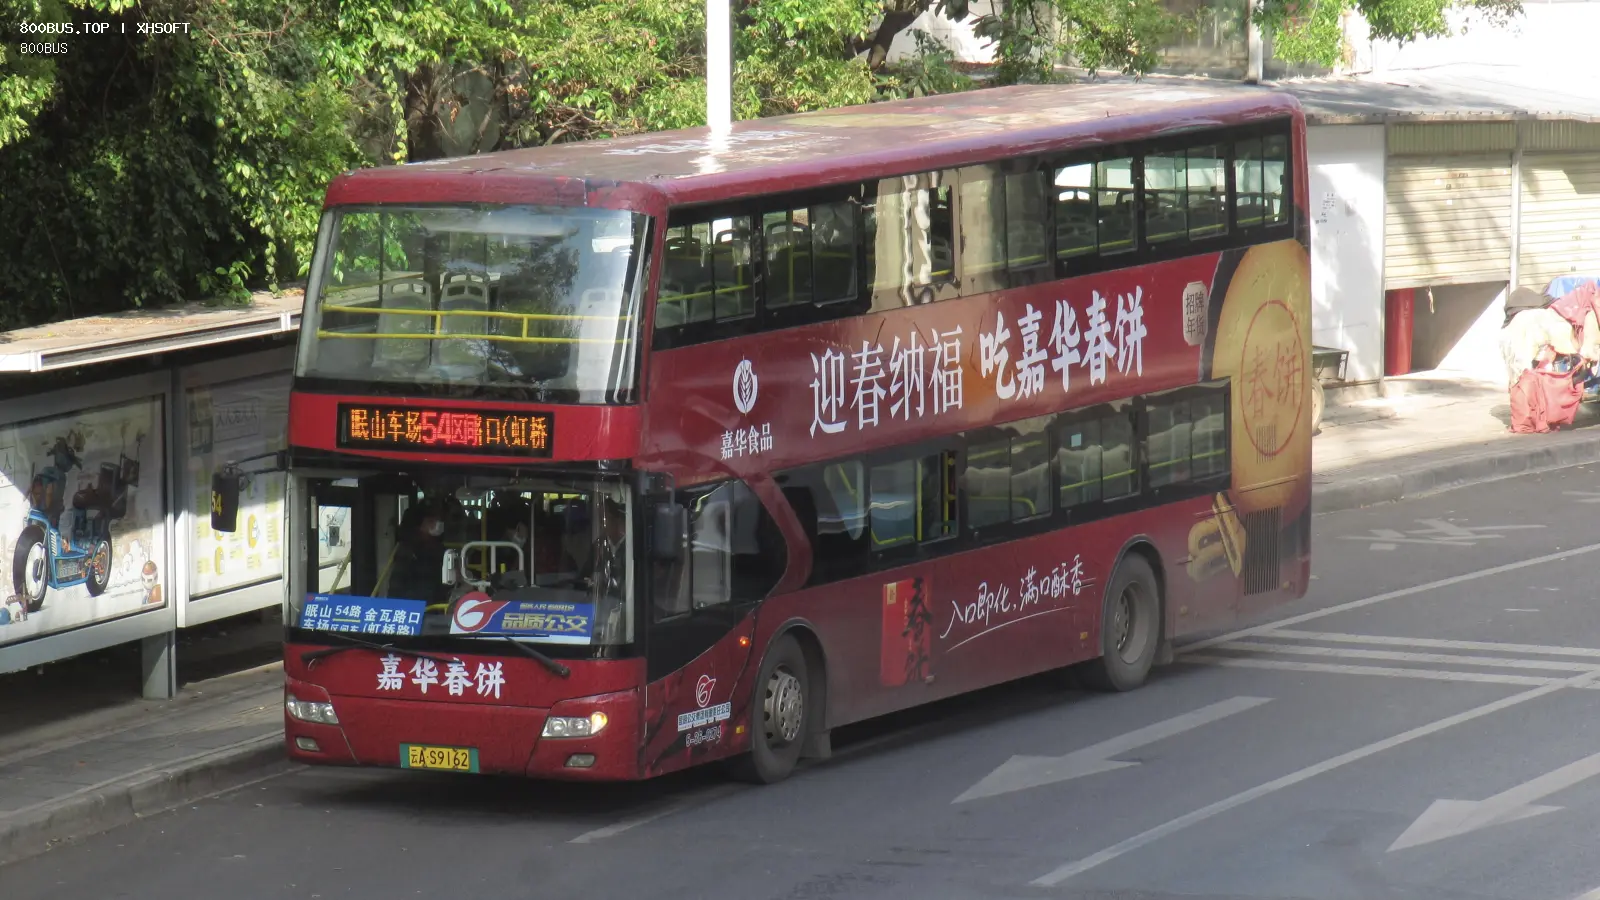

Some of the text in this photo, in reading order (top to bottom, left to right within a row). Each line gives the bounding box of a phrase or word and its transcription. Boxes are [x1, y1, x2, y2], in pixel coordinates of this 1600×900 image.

[1186, 293, 1205, 316] 招牌
[1186, 314, 1205, 338] 年货
[809, 285, 1148, 439] 迎春纳福 吃嘉华春饼
[720, 422, 773, 461] 嘉华食品
[211, 490, 222, 516] 54
[335, 604, 362, 618] 54路
[364, 607, 421, 624] 金瓦路口
[501, 612, 589, 633] 品质公交
[376, 652, 506, 699] 嘉华春饼
